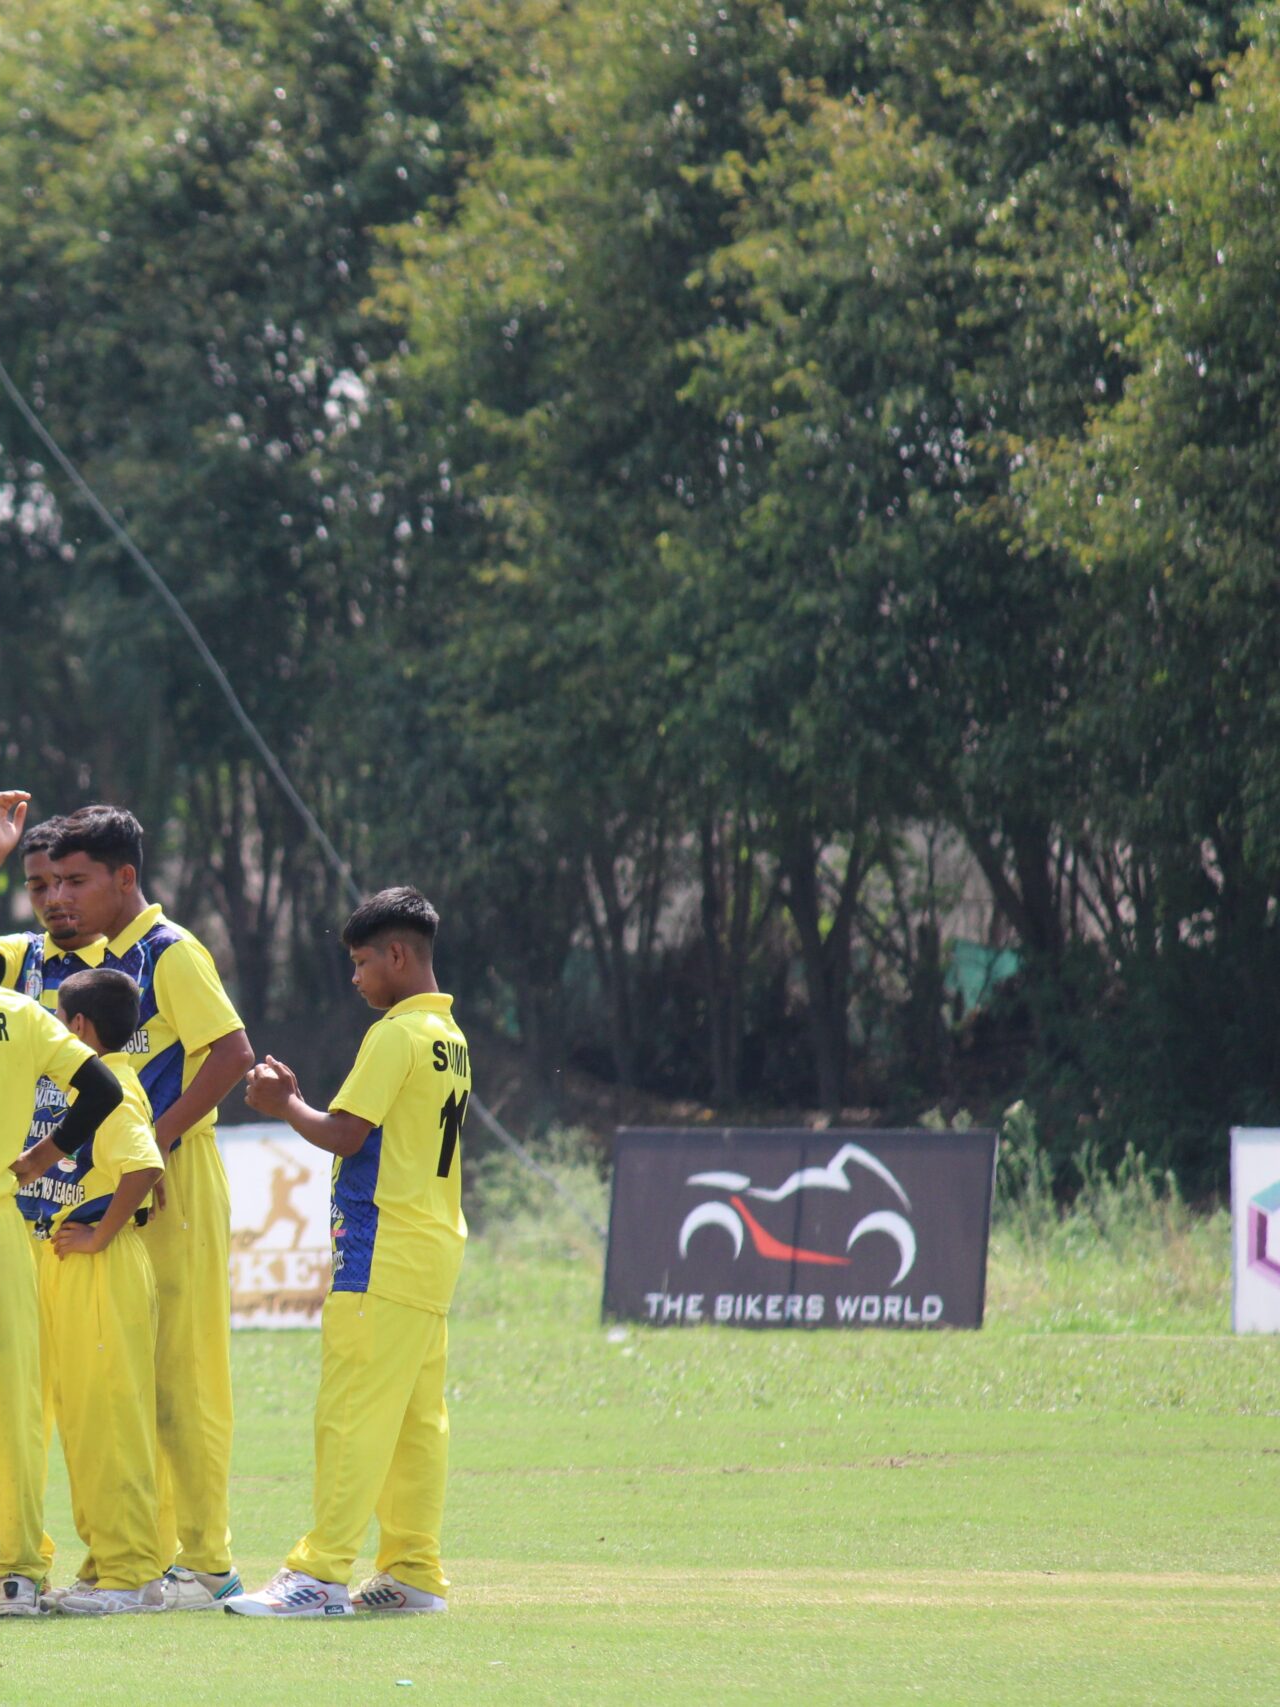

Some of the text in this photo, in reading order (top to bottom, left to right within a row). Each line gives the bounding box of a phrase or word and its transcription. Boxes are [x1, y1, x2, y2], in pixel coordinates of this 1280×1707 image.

[433, 1040, 469, 1078] SUMI
[53, 1180, 85, 1206] LEAGUE
[645, 1292, 944, 1322] THE BIKERS WORLD
